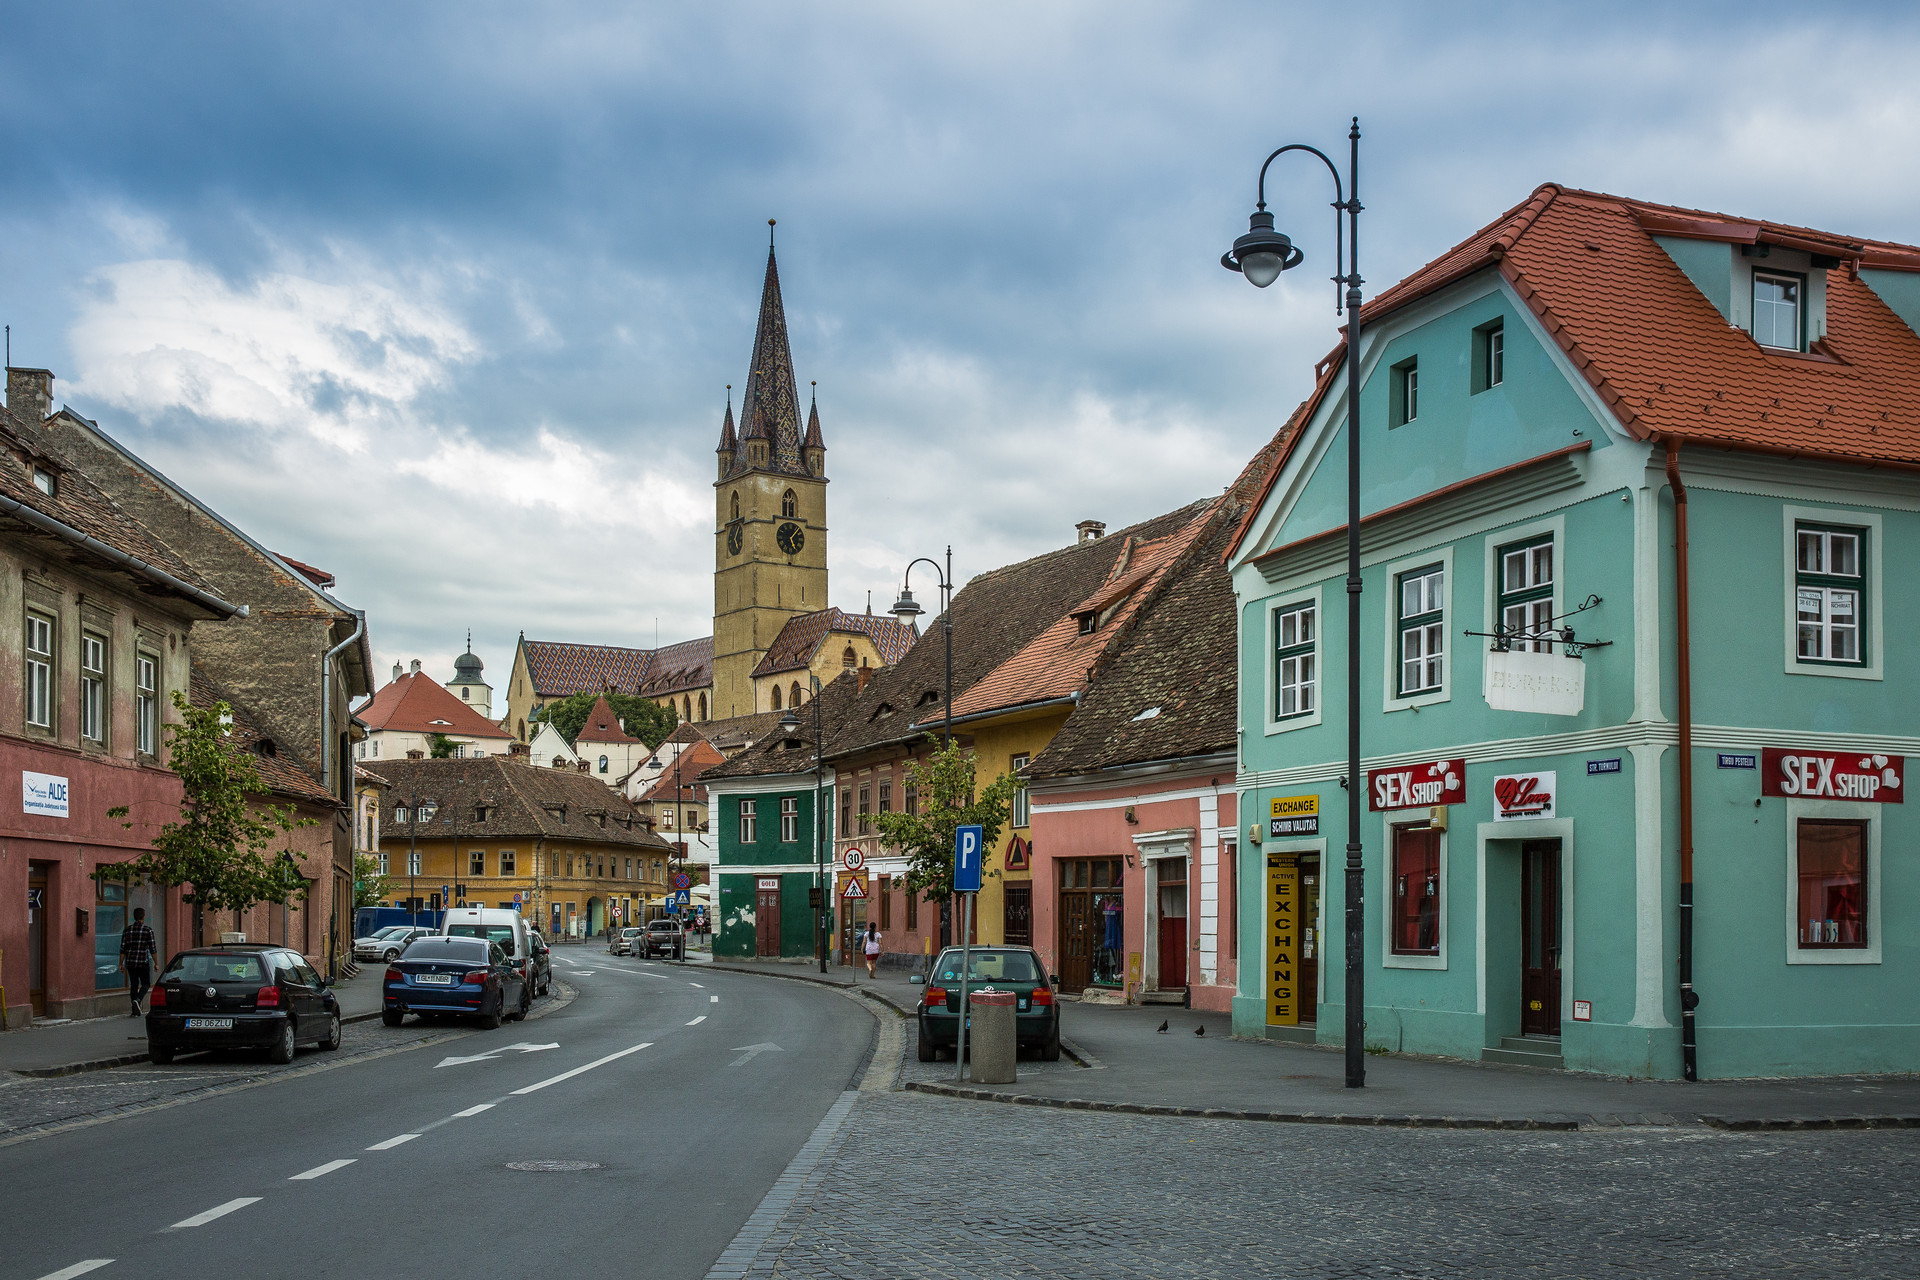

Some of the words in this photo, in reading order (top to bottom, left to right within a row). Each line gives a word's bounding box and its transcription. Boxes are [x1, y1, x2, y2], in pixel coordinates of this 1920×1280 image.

[1780, 755, 1835, 797] SEX
[1835, 773, 1880, 799] SHOP
[48, 782, 66, 801] ALDE
[1375, 771, 1413, 808] SEX
[1412, 781, 1444, 805] SHOP
[1511, 777, 1552, 806] Love
[1274, 800, 1314, 813] EXCHANGE
[1272, 820, 1292, 833] SCHIMB
[1292, 819, 1317, 832] VALUTAR
[848, 854, 860, 864] 30
[962, 832, 976, 868] P
[668, 898, 675, 908] P
[1274, 884, 1291, 1016] EXCHANGE
